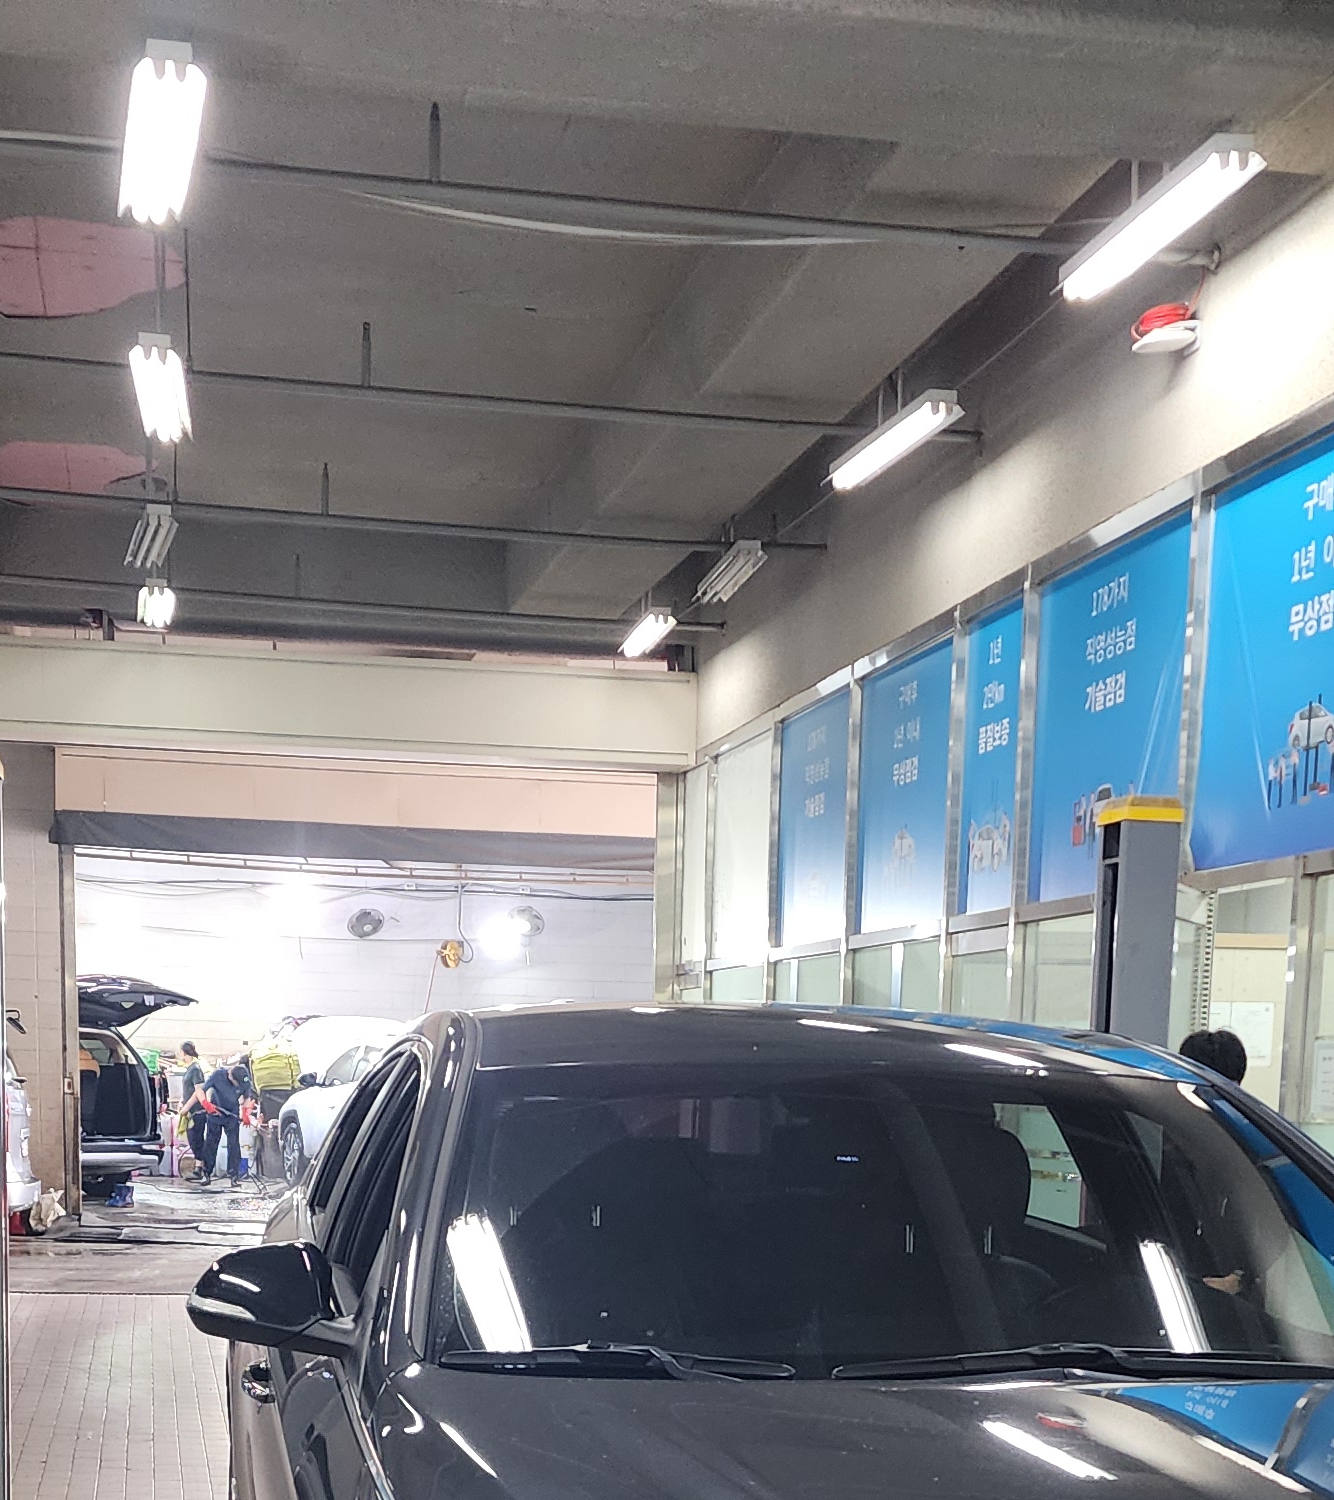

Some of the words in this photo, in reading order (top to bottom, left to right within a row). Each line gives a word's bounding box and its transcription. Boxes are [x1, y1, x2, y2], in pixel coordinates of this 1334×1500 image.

[1290, 539, 1316, 583] 1년
[1091, 572, 1129, 617] 178가지
[989, 634, 1002, 665] 1년
[1086, 618, 1136, 665] 직영성능점
[1085, 670, 1126, 712] 기술점검
[979, 718, 1009, 755] 품질보증
